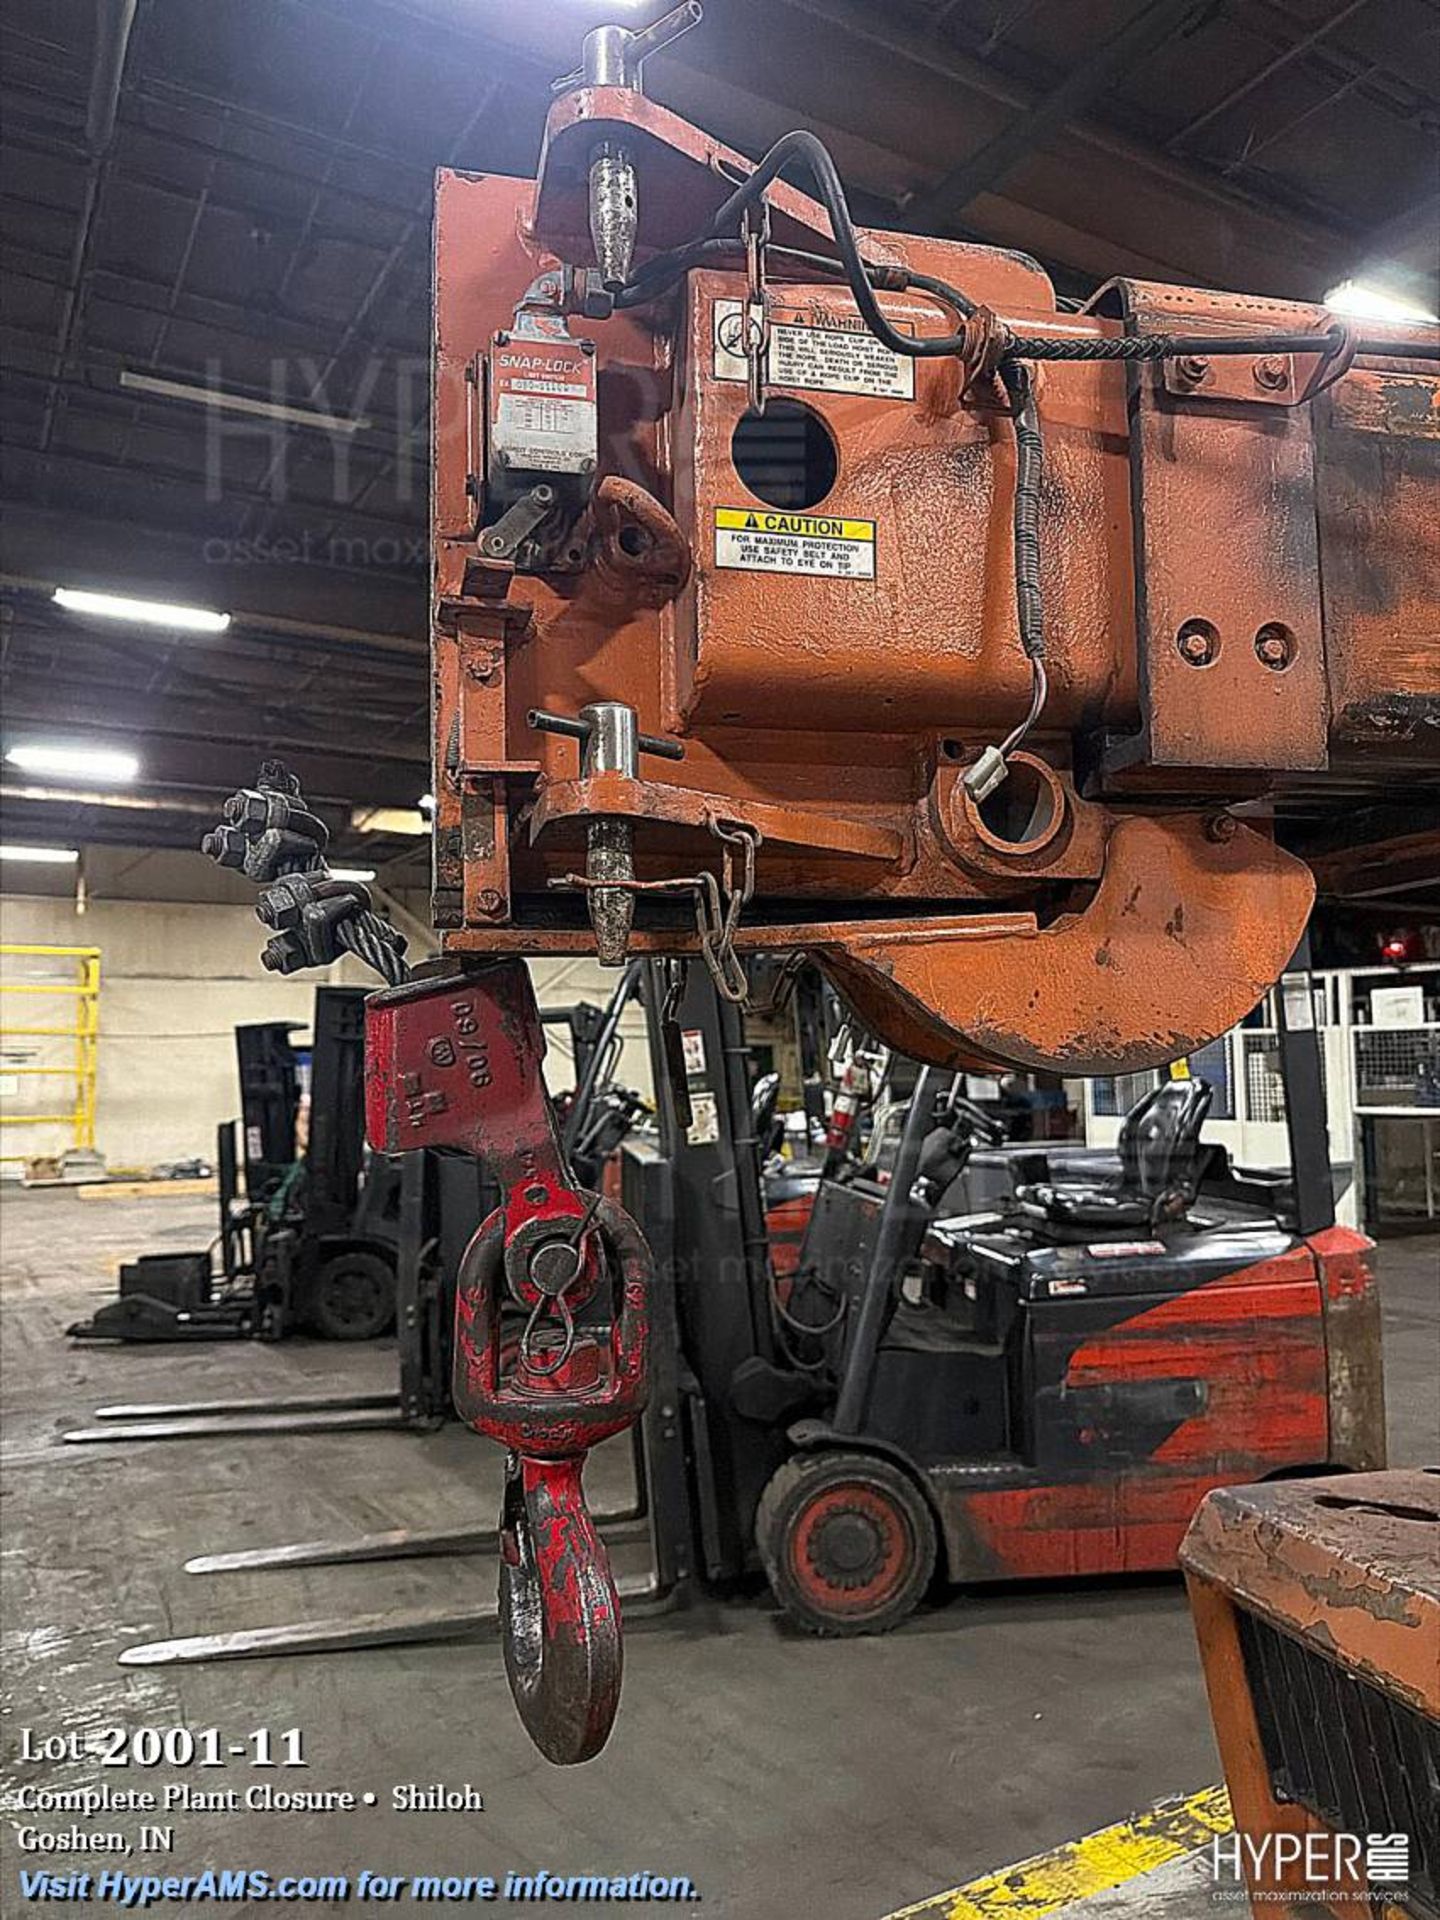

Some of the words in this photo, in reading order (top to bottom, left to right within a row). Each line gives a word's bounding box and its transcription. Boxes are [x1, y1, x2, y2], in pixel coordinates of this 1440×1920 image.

[828, 342, 850, 350] LOAD
[820, 349, 860, 359] SERIOUSLY
[864, 354, 896, 363] WEAKEN
[825, 357, 850, 365] DEATH
[867, 362, 899, 371] SERIOUS
[828, 365, 857, 373] RESULT
[859, 368, 881, 376] FROM
[764, 515, 843, 536] CAUTION
[731, 534, 750, 543] FOR
[754, 536, 799, 547] MAXIMUM
[802, 540, 860, 553] PROTECTION
[740, 544, 760, 553] USE
[763, 546, 799, 556] SAFETY
[803, 549, 826, 559] BELT
[830, 552, 850, 561] AND
[740, 553, 777, 564] ATTACH
[781, 557, 794, 566] TO
[797, 559, 816, 568] EYE
[819, 560, 833, 569] ON
[838, 562, 851, 570] TIP
